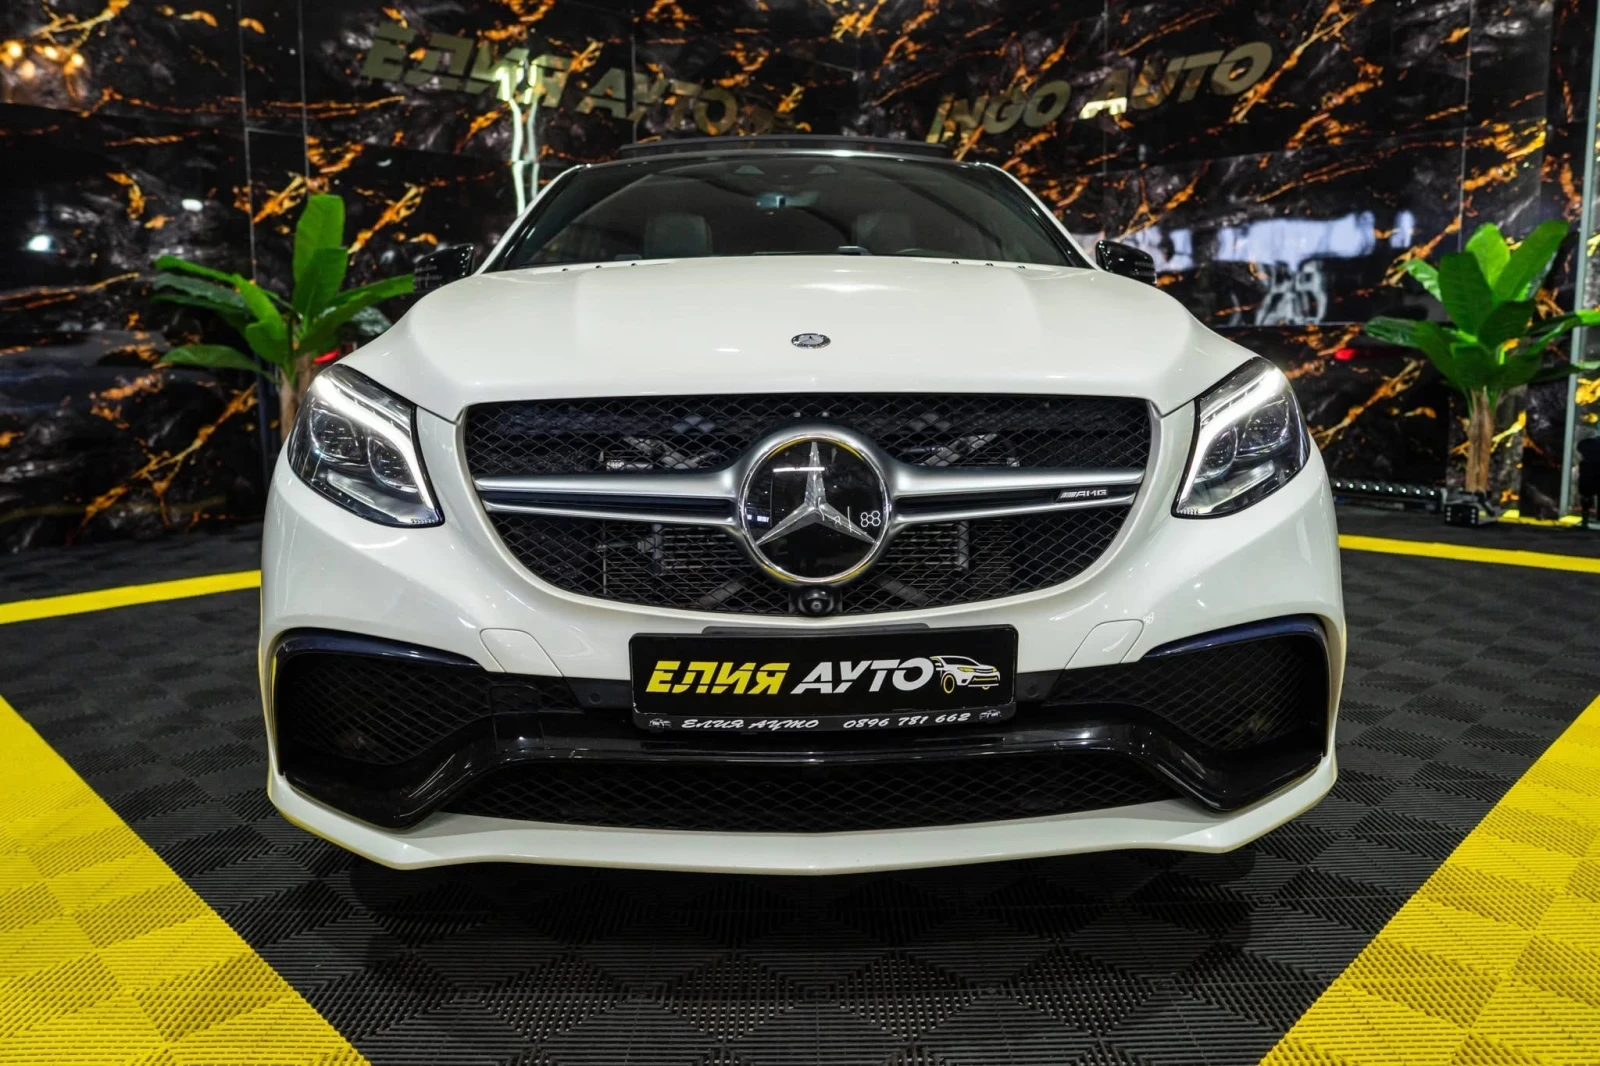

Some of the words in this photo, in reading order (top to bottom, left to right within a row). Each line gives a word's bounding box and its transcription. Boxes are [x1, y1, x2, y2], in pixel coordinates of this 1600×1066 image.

[926, 79, 1071, 144] INGO
[1079, 41, 1273, 119] AUTO
[645, 660, 790, 695] ЕЛИЯ
[790, 656, 934, 693] АУТО
[843, 718, 890, 729] 0896
[898, 715, 929, 726] 781
[935, 712, 971, 723] 662
